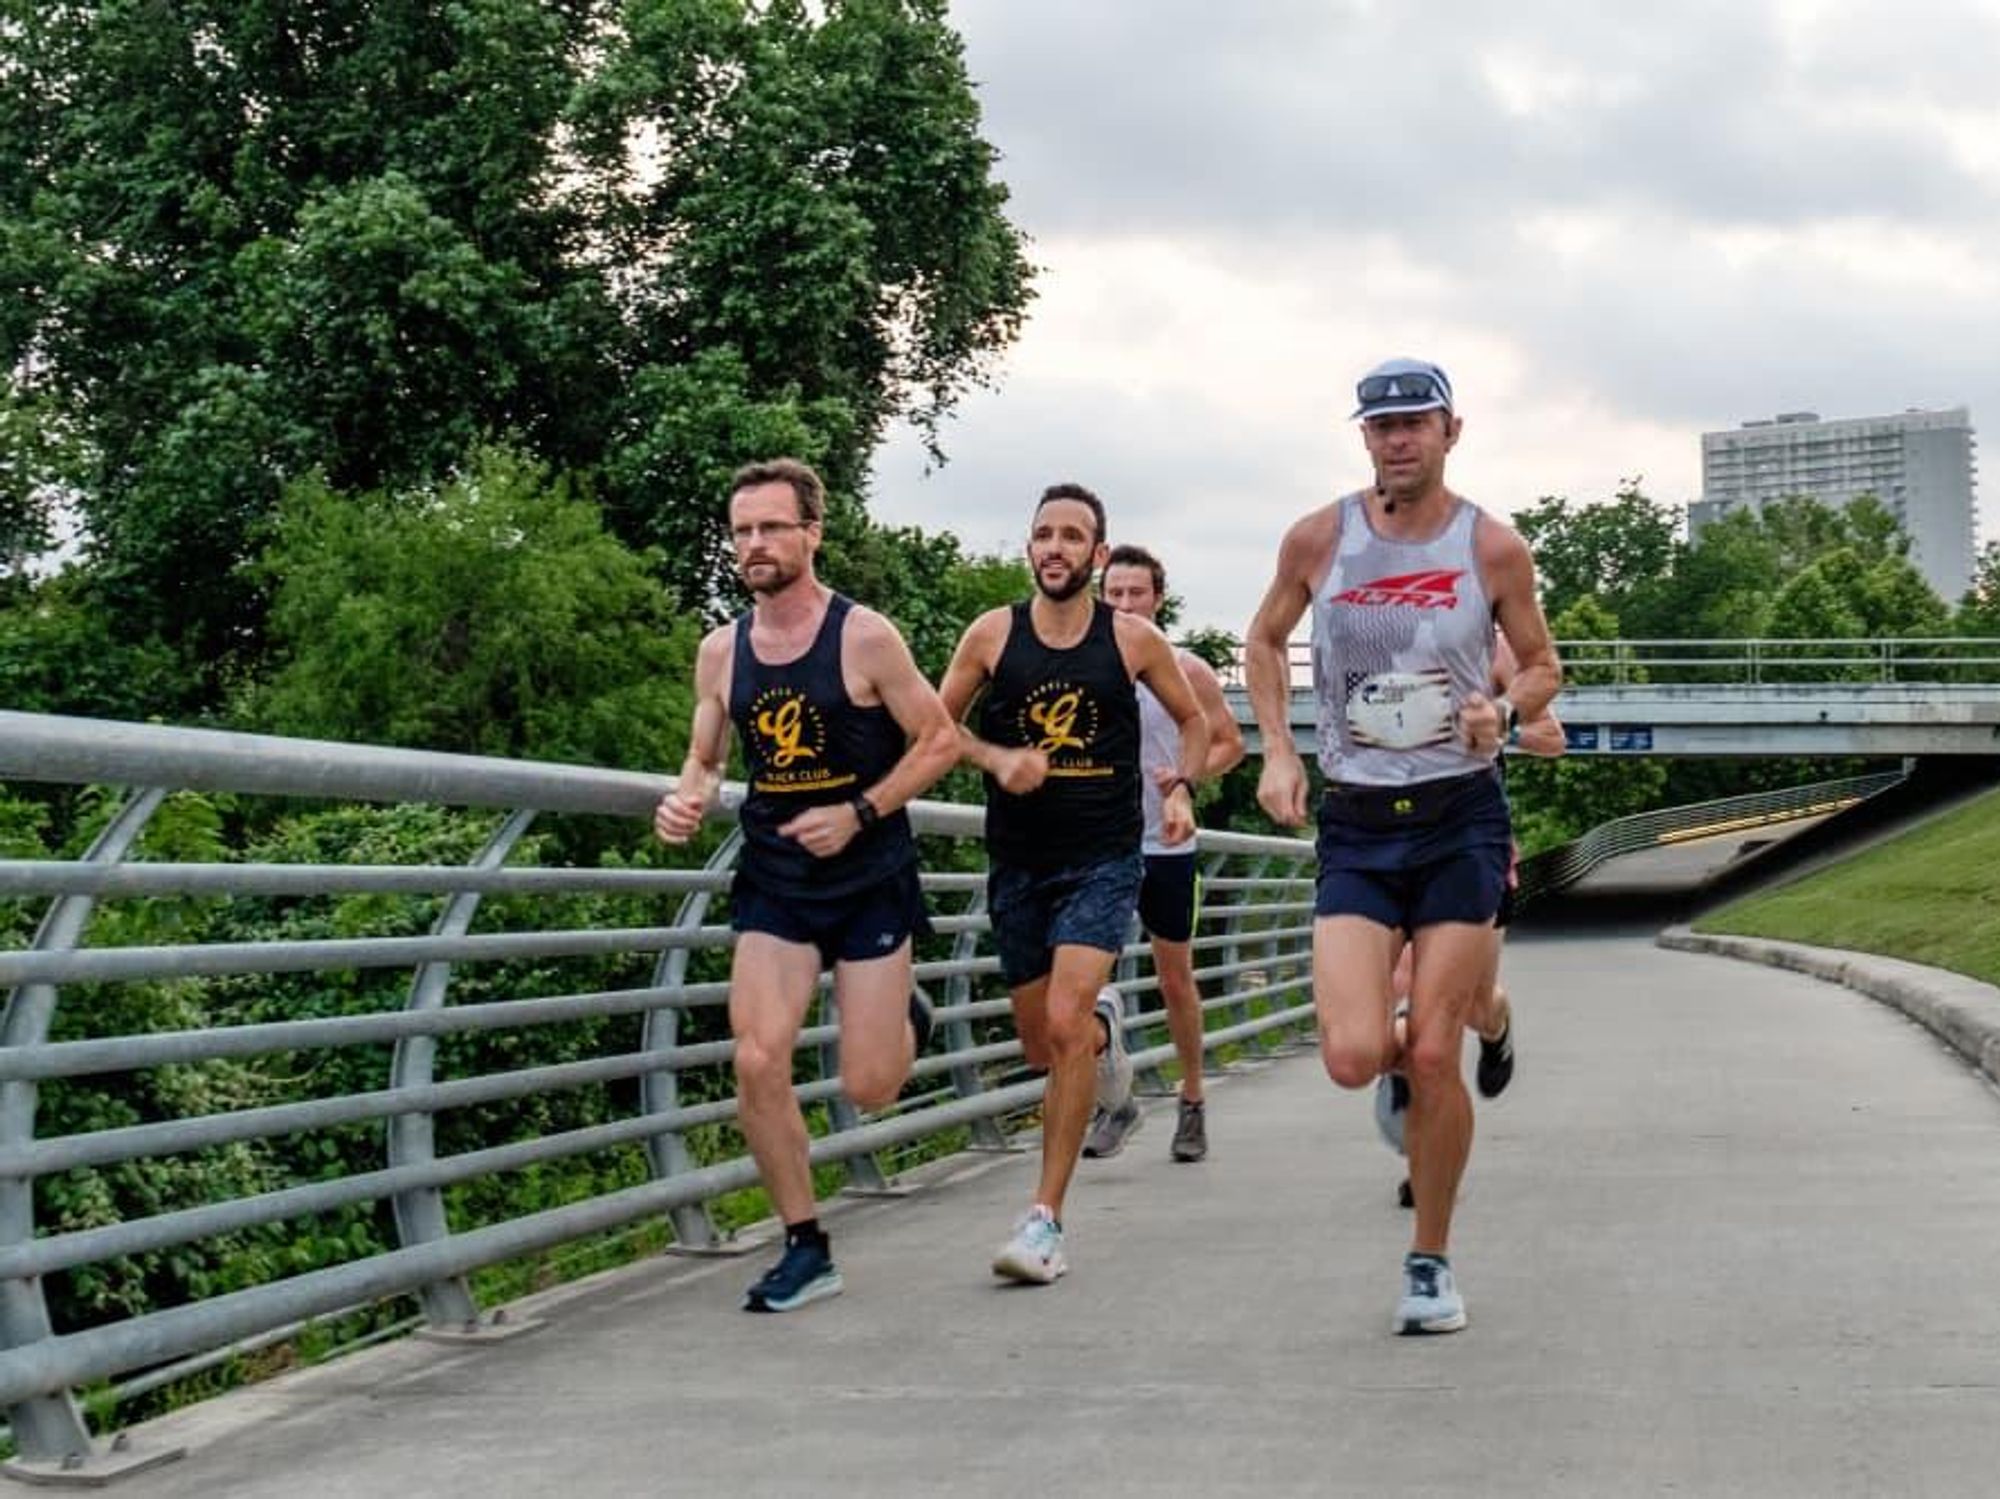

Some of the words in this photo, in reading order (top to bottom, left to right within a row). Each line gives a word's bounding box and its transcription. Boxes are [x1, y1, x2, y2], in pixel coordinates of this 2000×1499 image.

[1330, 588, 1458, 610] ALTRA
[1395, 711, 1404, 728] 1
[799, 767, 831, 781] CLUB
